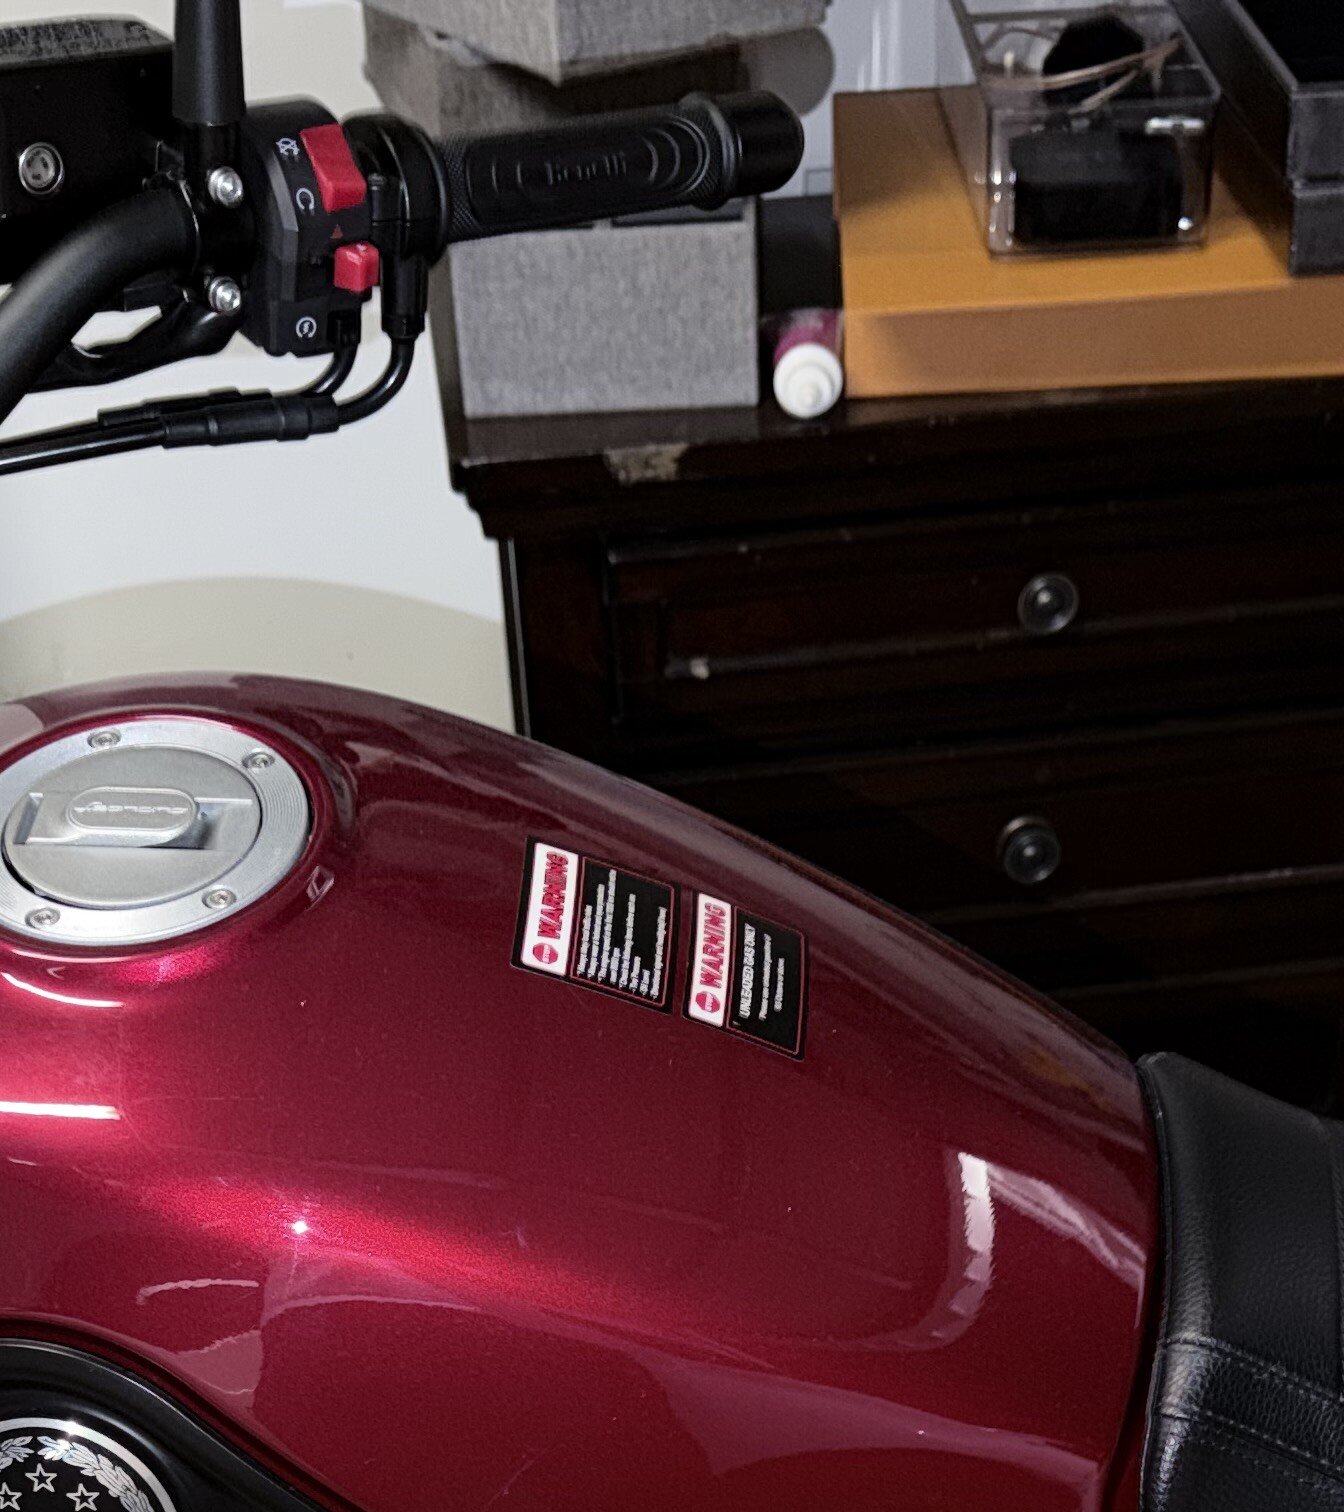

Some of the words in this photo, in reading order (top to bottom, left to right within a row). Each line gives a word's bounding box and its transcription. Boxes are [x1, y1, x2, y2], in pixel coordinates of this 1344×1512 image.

[537, 851, 569, 940] WARNING
[699, 902, 727, 989] WARNING
[738, 966, 755, 1020] UNLEADED
